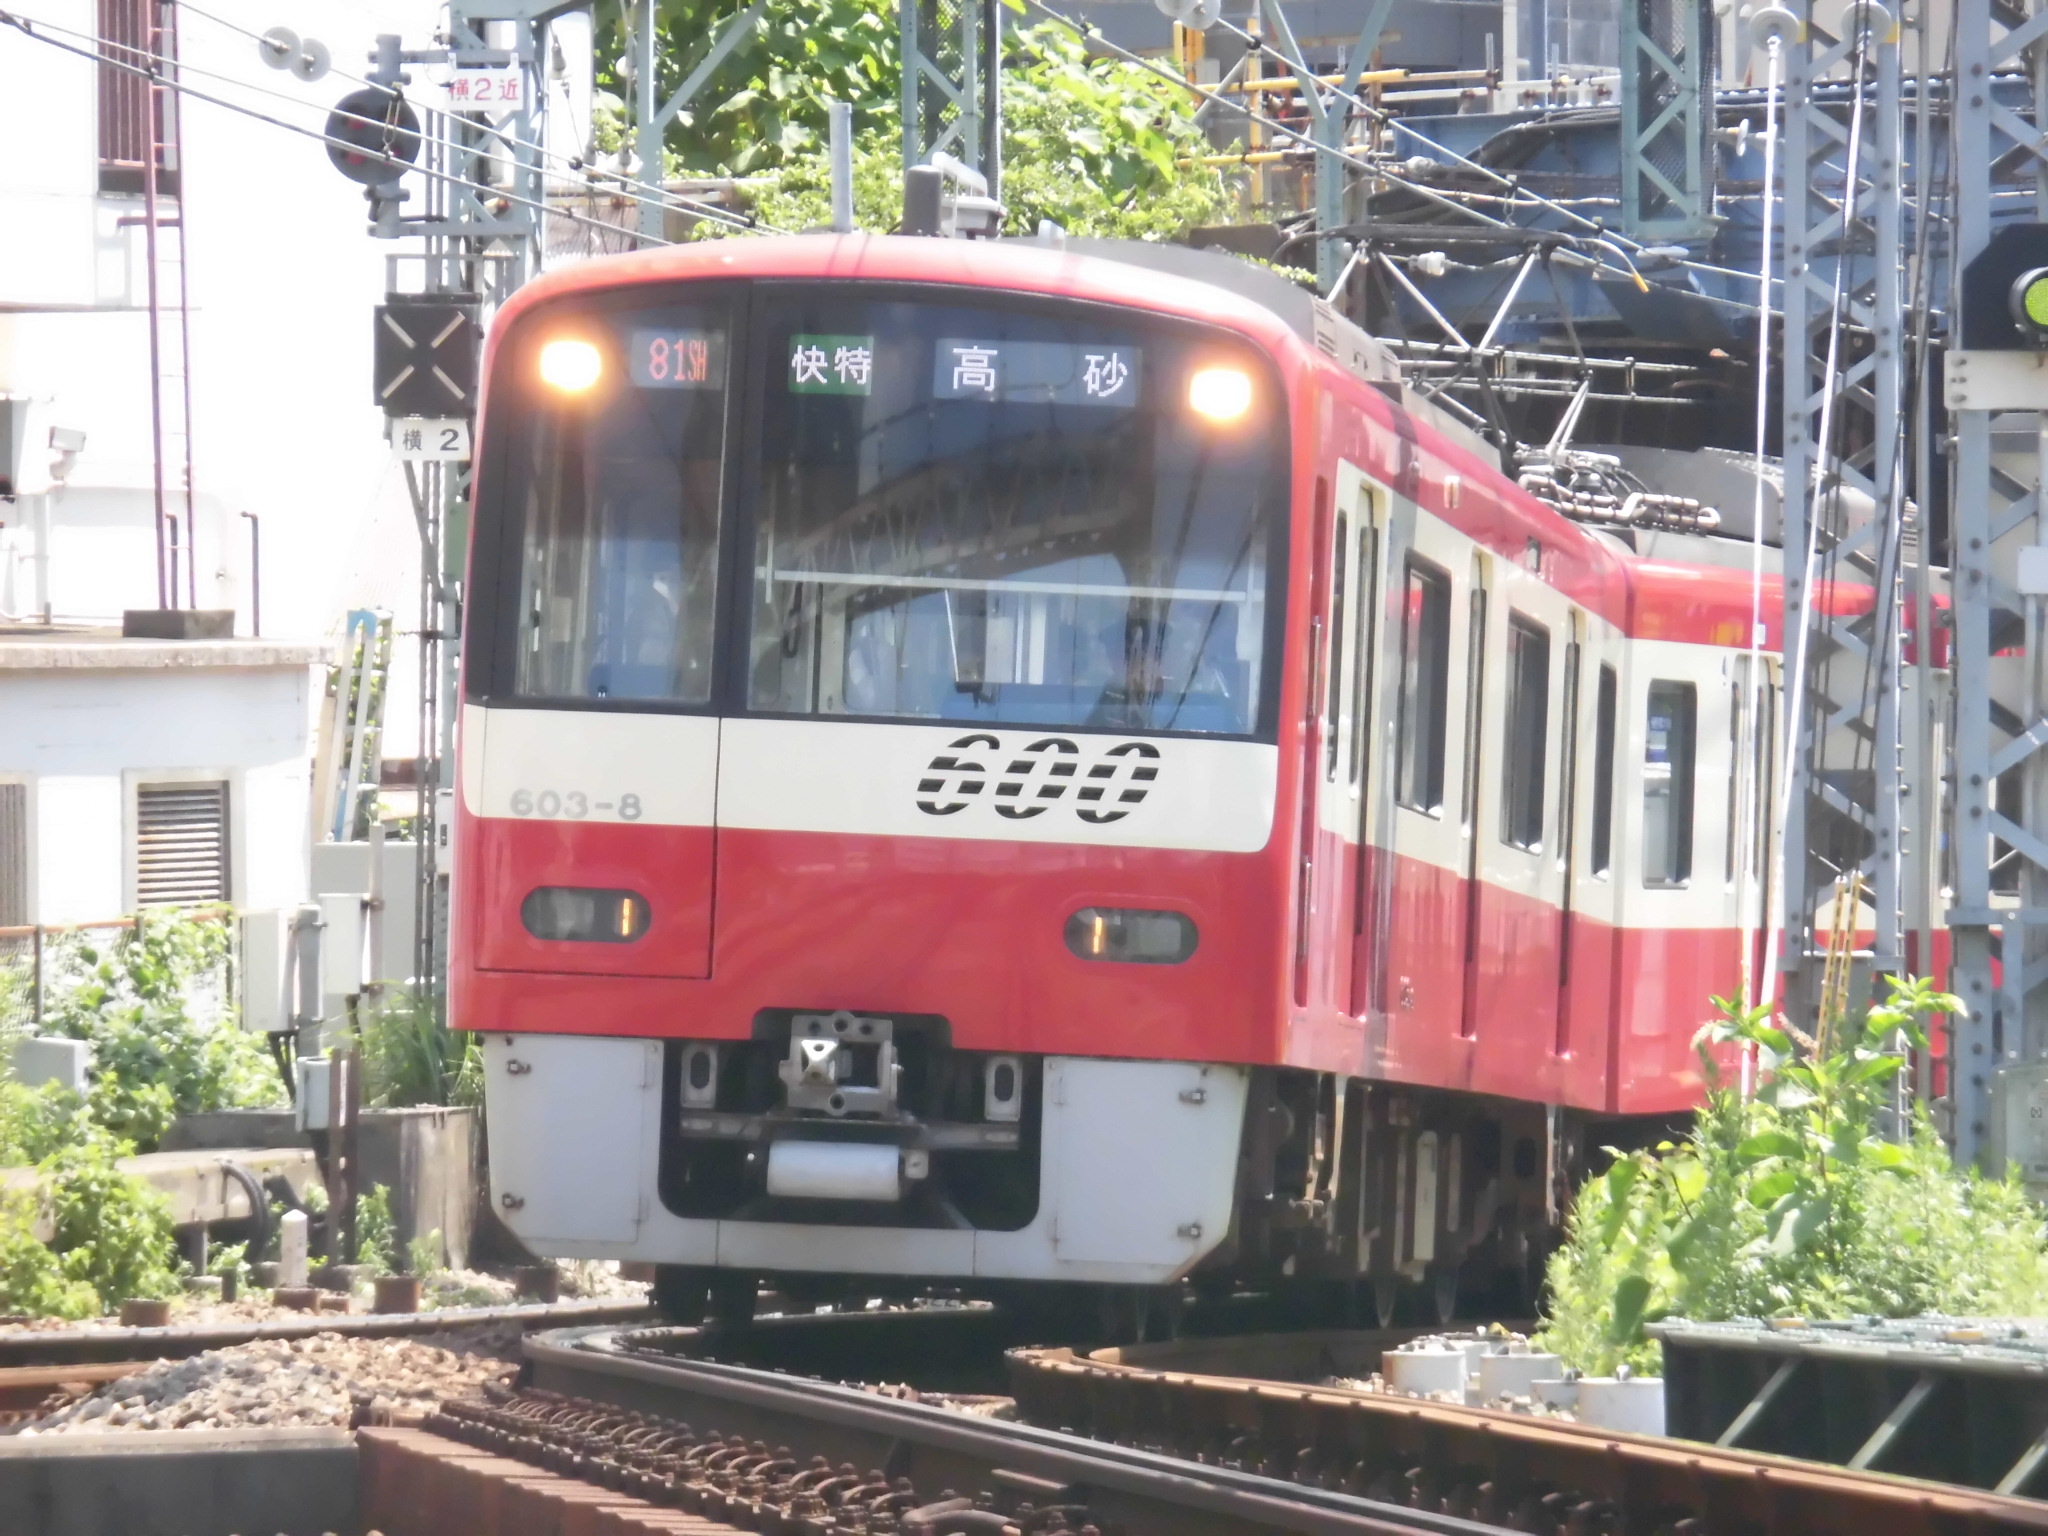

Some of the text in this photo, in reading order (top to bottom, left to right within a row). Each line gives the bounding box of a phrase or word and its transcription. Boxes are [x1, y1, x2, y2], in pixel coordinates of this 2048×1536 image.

[649, 337, 708, 382] 81SH
[791, 345, 872, 385] 快特
[915, 733, 1162, 824] 600
[509, 788, 643, 821] 603-8
